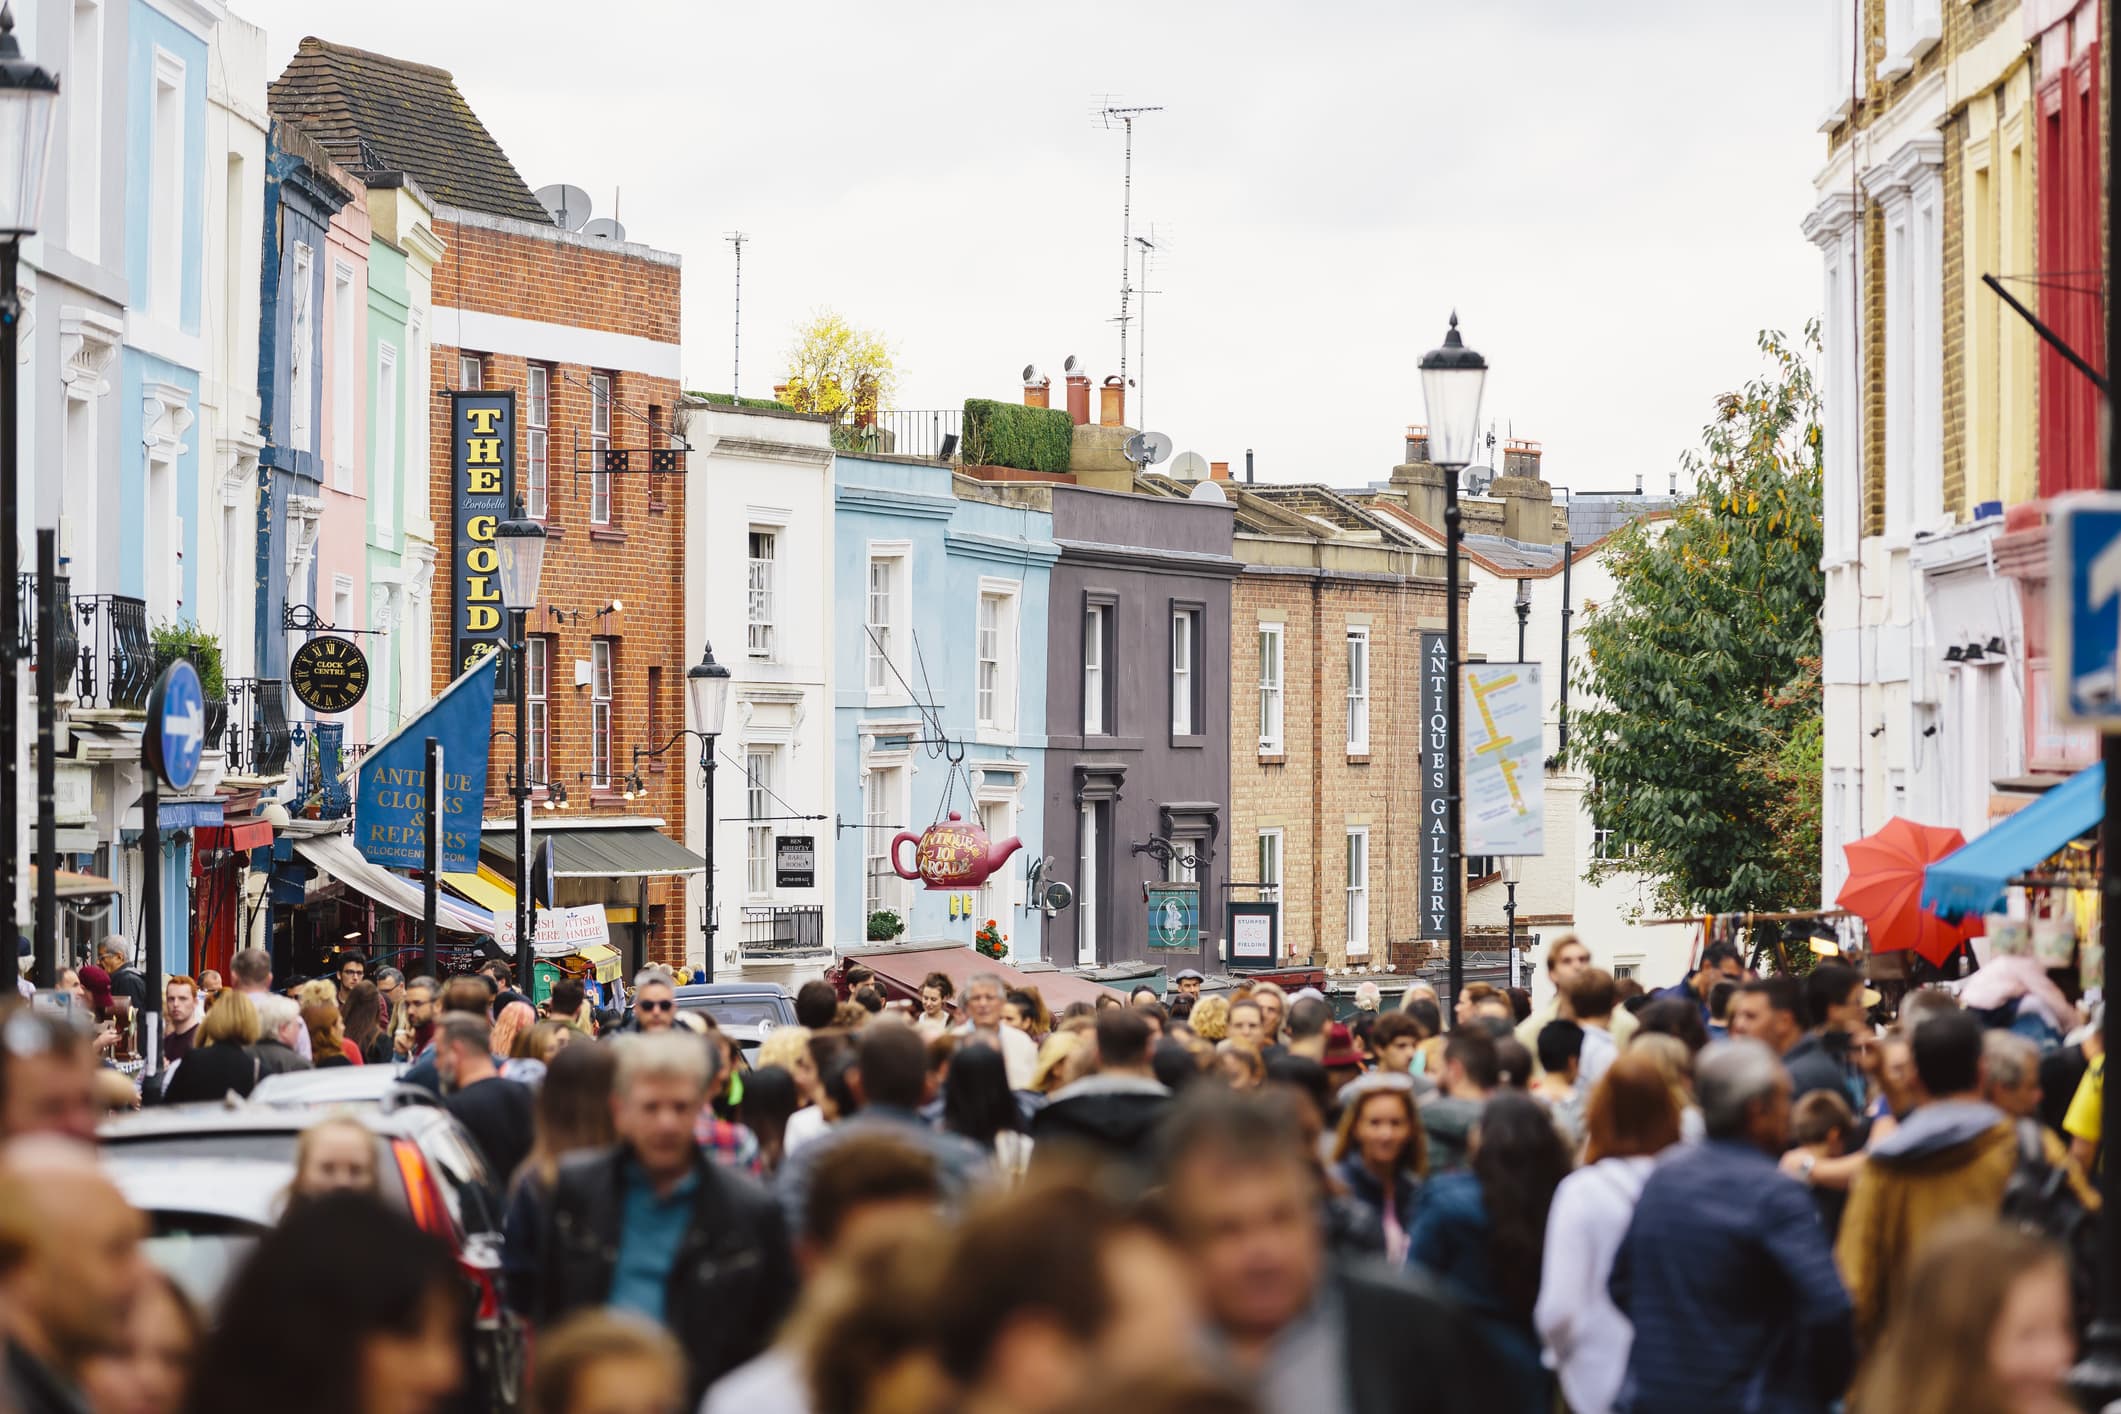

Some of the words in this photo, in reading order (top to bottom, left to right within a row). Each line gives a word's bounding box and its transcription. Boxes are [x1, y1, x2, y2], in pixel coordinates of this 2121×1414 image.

[466, 408, 502, 494] THE
[462, 497, 506, 510] Portobello
[466, 515, 501, 632] GOLD
[313, 668, 346, 676] CENTRE
[316, 661, 344, 669] CLOCK
[1430, 637, 1448, 789] ANTIQUES
[372, 767, 473, 793] ANTIUE
[370, 824, 467, 850] REPARS
[918, 832, 977, 853] ANTIQUE
[919, 856, 974, 877] ARCADE
[1430, 798, 1447, 932] GALLERY
